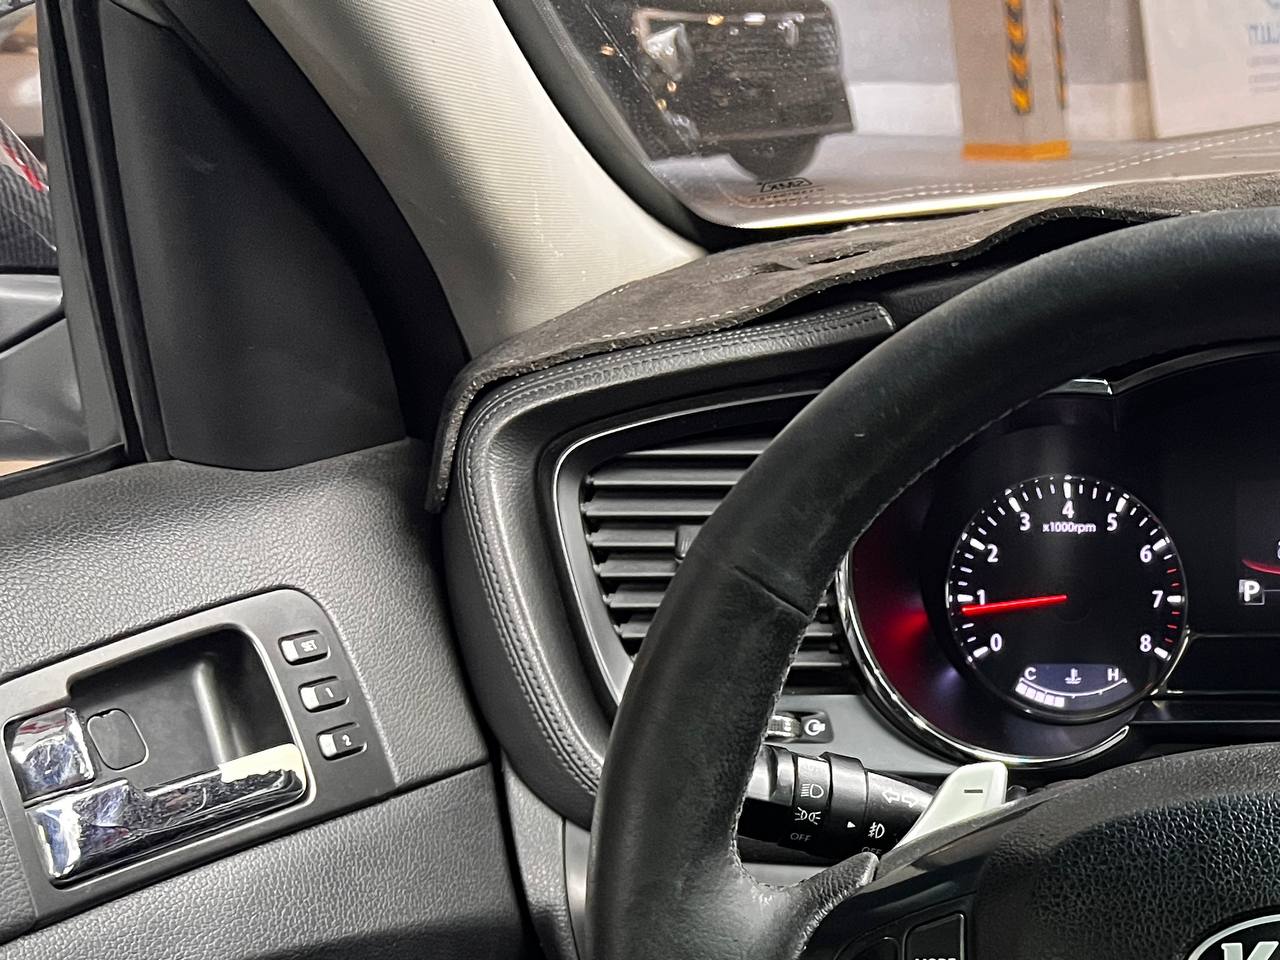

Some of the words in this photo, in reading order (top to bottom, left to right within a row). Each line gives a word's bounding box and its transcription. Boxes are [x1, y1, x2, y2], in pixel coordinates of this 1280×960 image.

[1062, 500, 1074, 518] 4
[1020, 513, 1030, 531] 3
[1042, 522, 1096, 535] x1000rpm
[1106, 513, 1117, 531] 5
[987, 544, 999, 562] 2
[1140, 544, 1152, 562] 6
[976, 589, 985, 605] 1
[1152, 590, 1163, 608] 7
[1244, 580, 1260, 602] P
[301, 639, 318, 652] SET
[990, 633, 1002, 652] 0
[1140, 634, 1151, 652] 8
[1024, 668, 1036, 680] C
[1107, 669, 1119, 680] H
[790, 832, 812, 842] OFF
